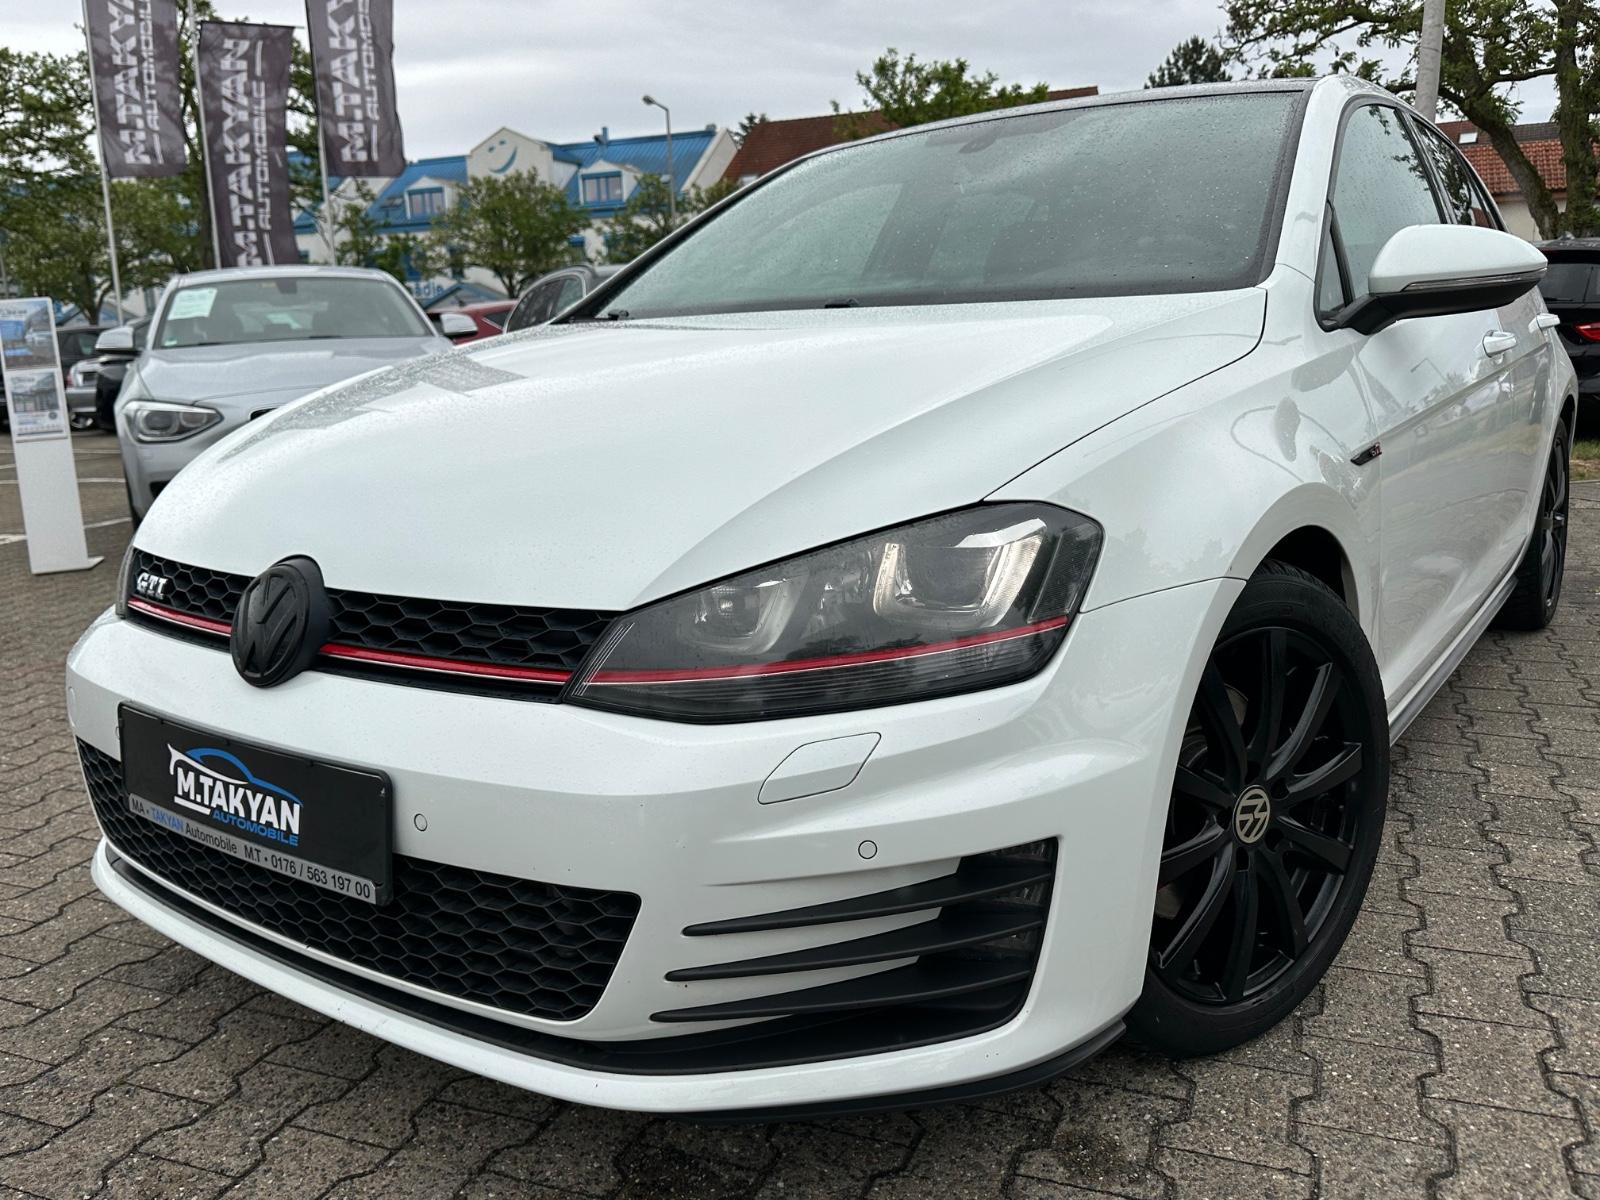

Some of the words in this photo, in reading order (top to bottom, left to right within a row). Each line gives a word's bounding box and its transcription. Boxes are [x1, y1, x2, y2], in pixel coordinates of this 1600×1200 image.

[220, 38, 262, 266] M.TAKYAN
[253, 80, 271, 230] AUTOMOBILE
[137, 572, 168, 599] GTI
[177, 767, 300, 834] M.TAKYAN
[213, 810, 299, 846] AUTOMOBILE
[132, 798, 146, 814] MA
[151, 807, 184, 832] TAKYAN
[186, 823, 237, 854] Automobile
[244, 845, 261, 862] M.T
[271, 854, 296, 875] 0176
[307, 866, 328, 884] 563
[331, 875, 351, 892] 197
[355, 881, 370, 898] 00
